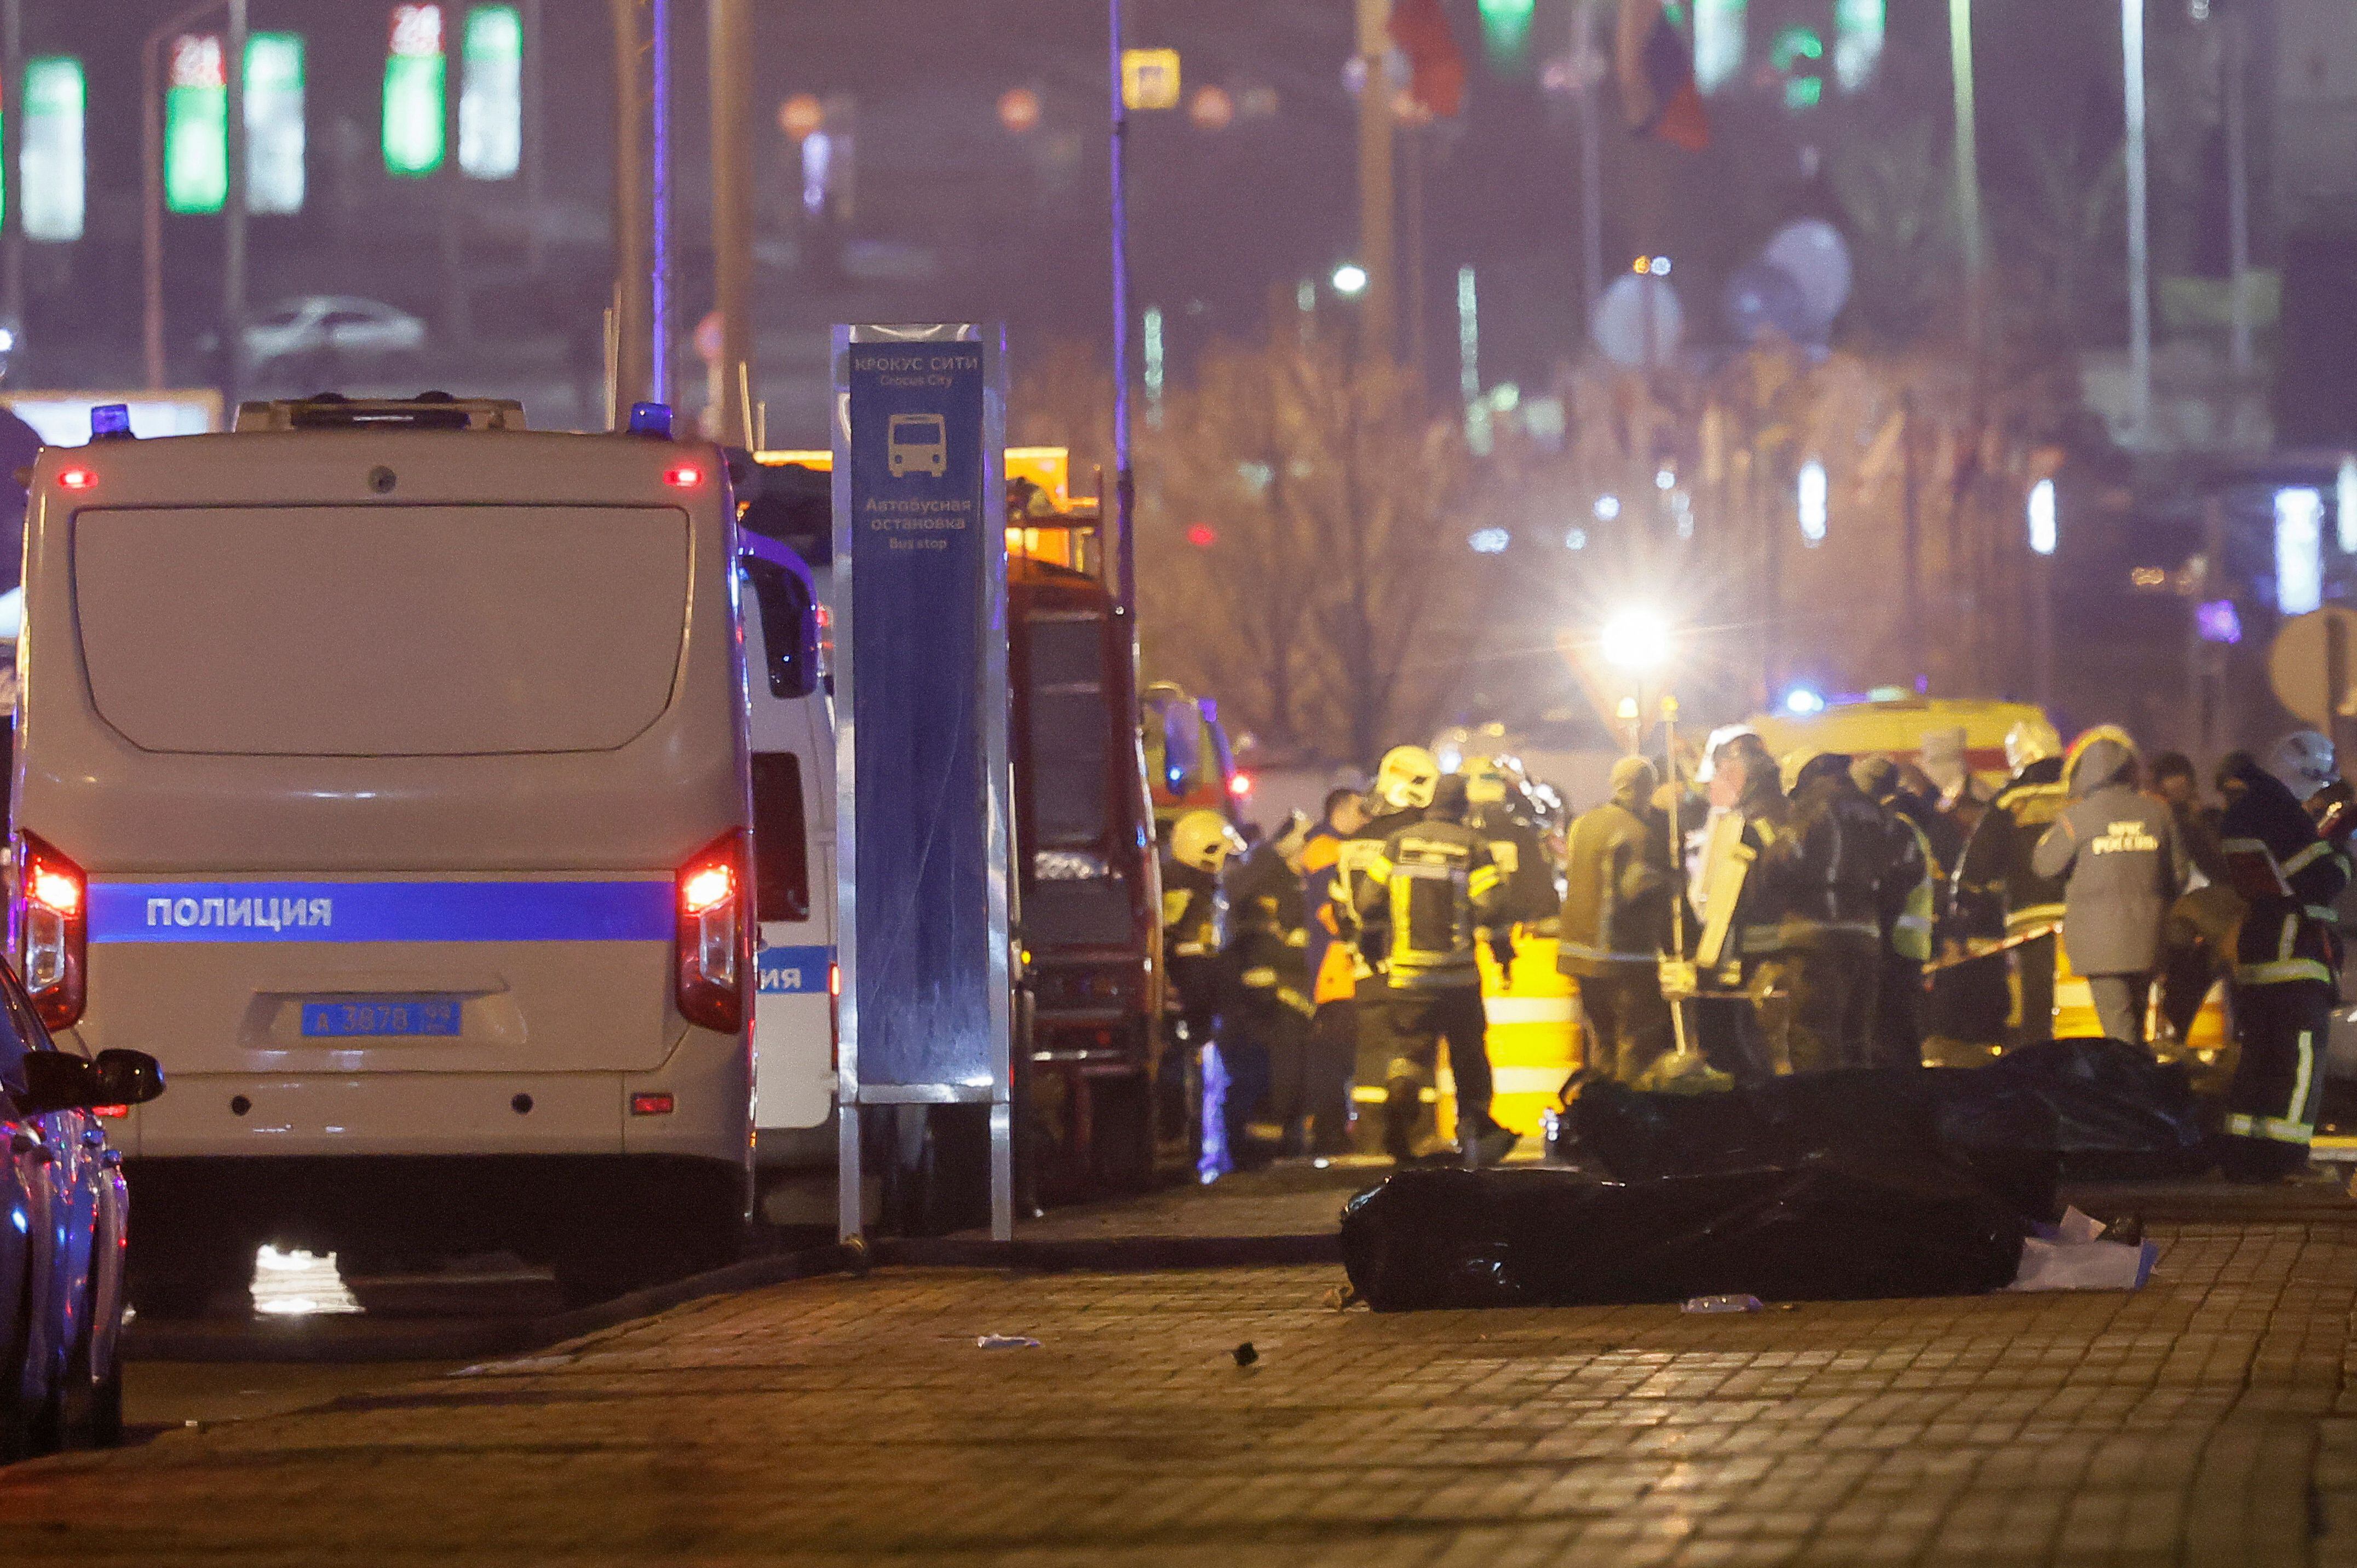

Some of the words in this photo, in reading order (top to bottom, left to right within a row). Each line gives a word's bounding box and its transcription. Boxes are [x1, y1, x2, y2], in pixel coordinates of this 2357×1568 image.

[854, 357, 923, 371] КРОКУС
[931, 356, 978, 370] СИТИ
[866, 497, 970, 514] Автобусная
[871, 517, 965, 531] остановка
[889, 537, 914, 549] Bus
[917, 538, 946, 551] stop
[147, 898, 331, 932] ПОЛИЦИЯ
